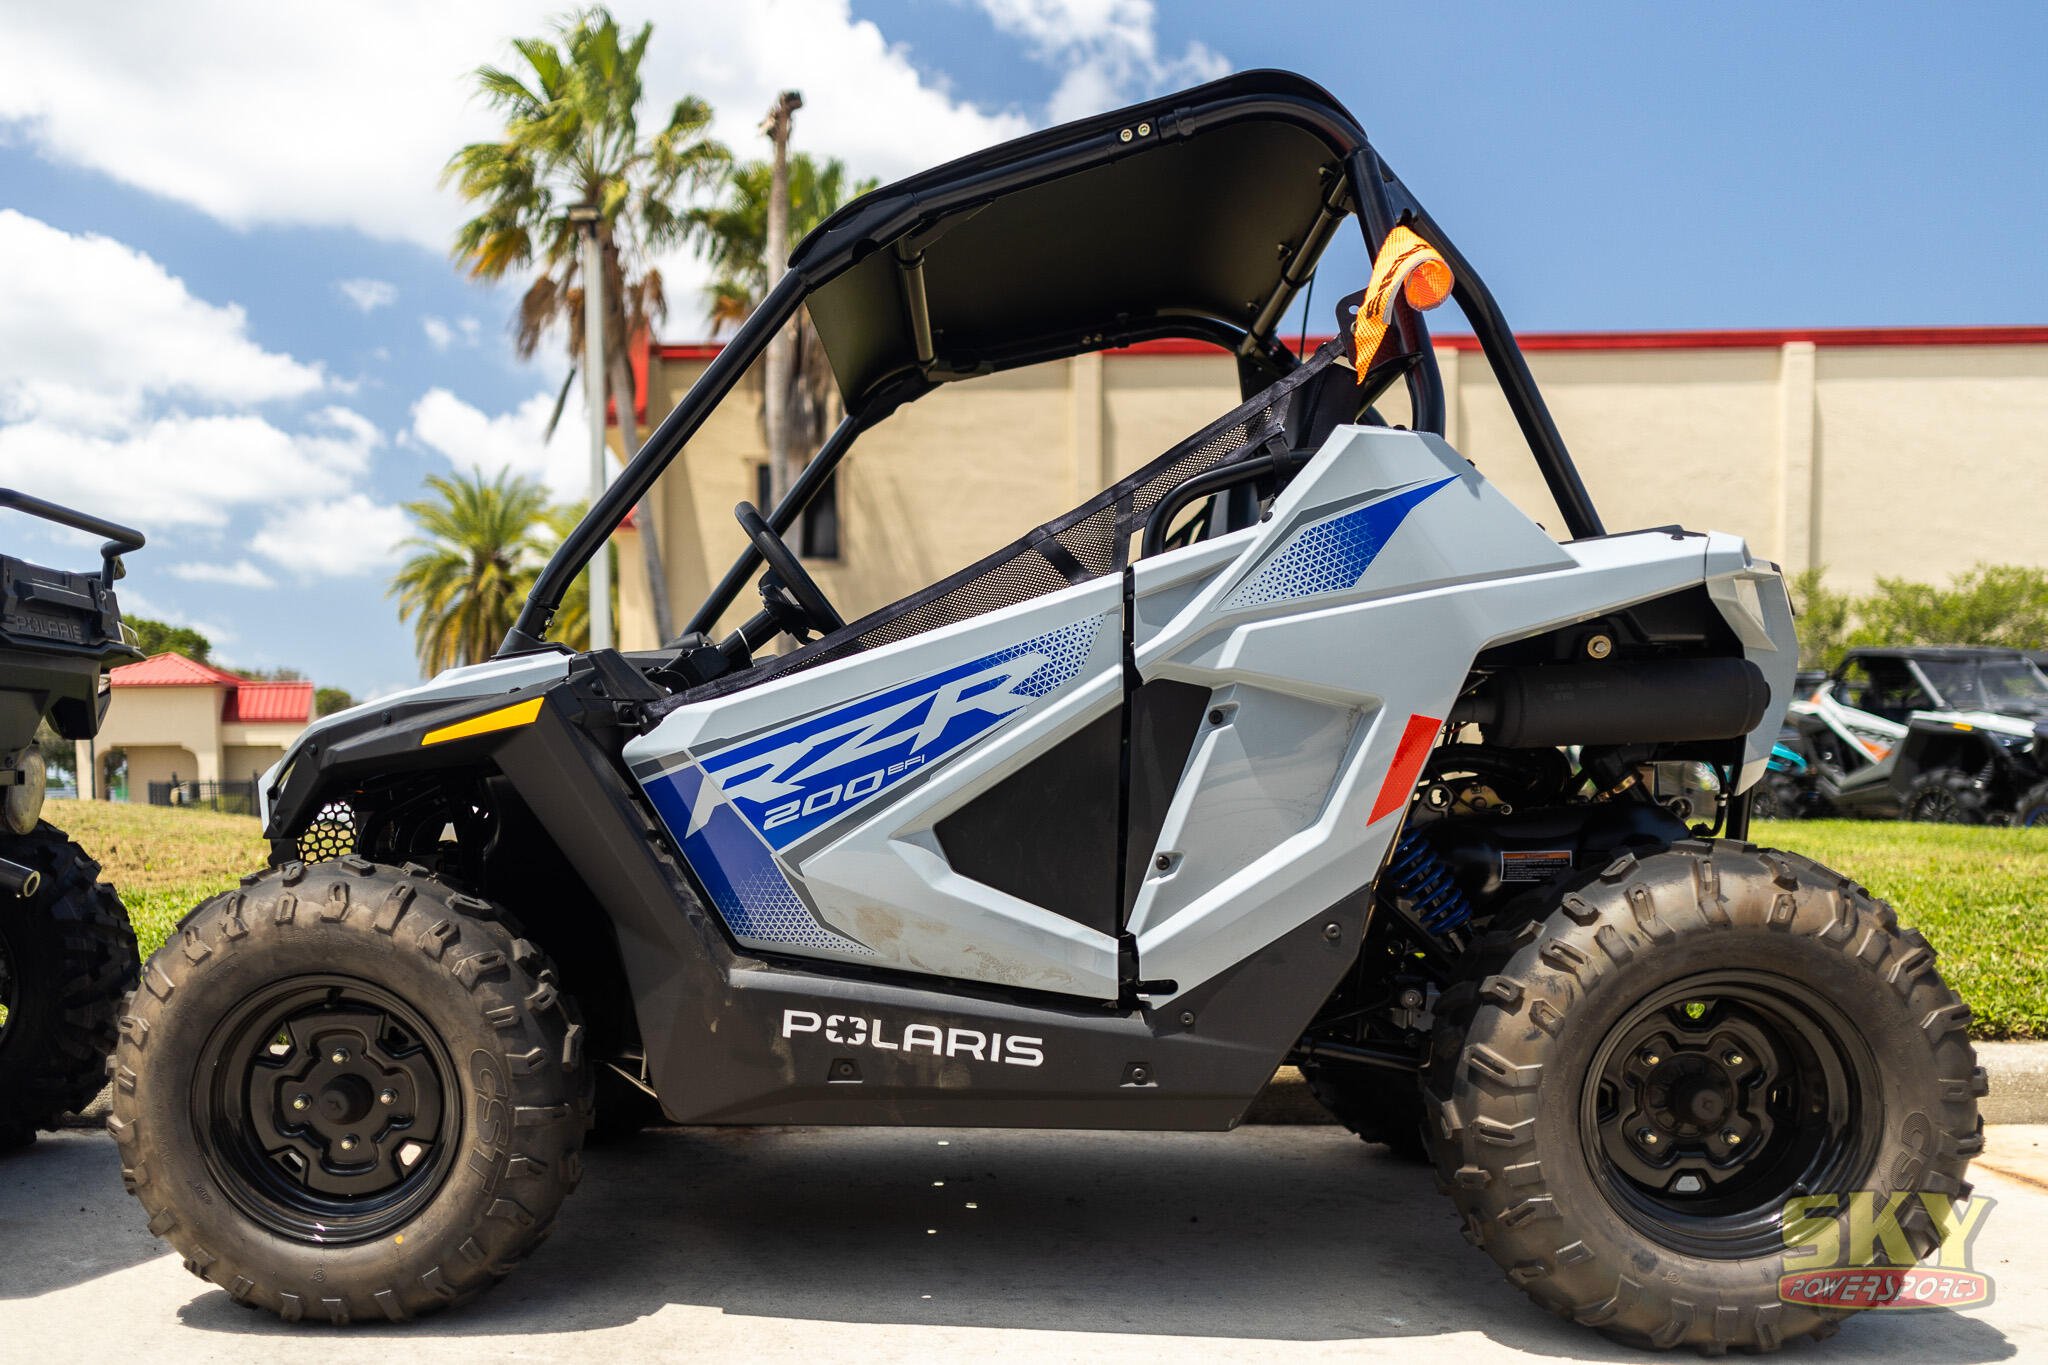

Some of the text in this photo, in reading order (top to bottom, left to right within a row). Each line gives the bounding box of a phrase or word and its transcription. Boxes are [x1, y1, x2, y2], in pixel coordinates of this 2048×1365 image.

[16, 615, 82, 640] POLARIS
[685, 651, 1051, 839] RZR
[782, 1009, 1043, 1067] POLARIS
[468, 1048, 509, 1194] CST
